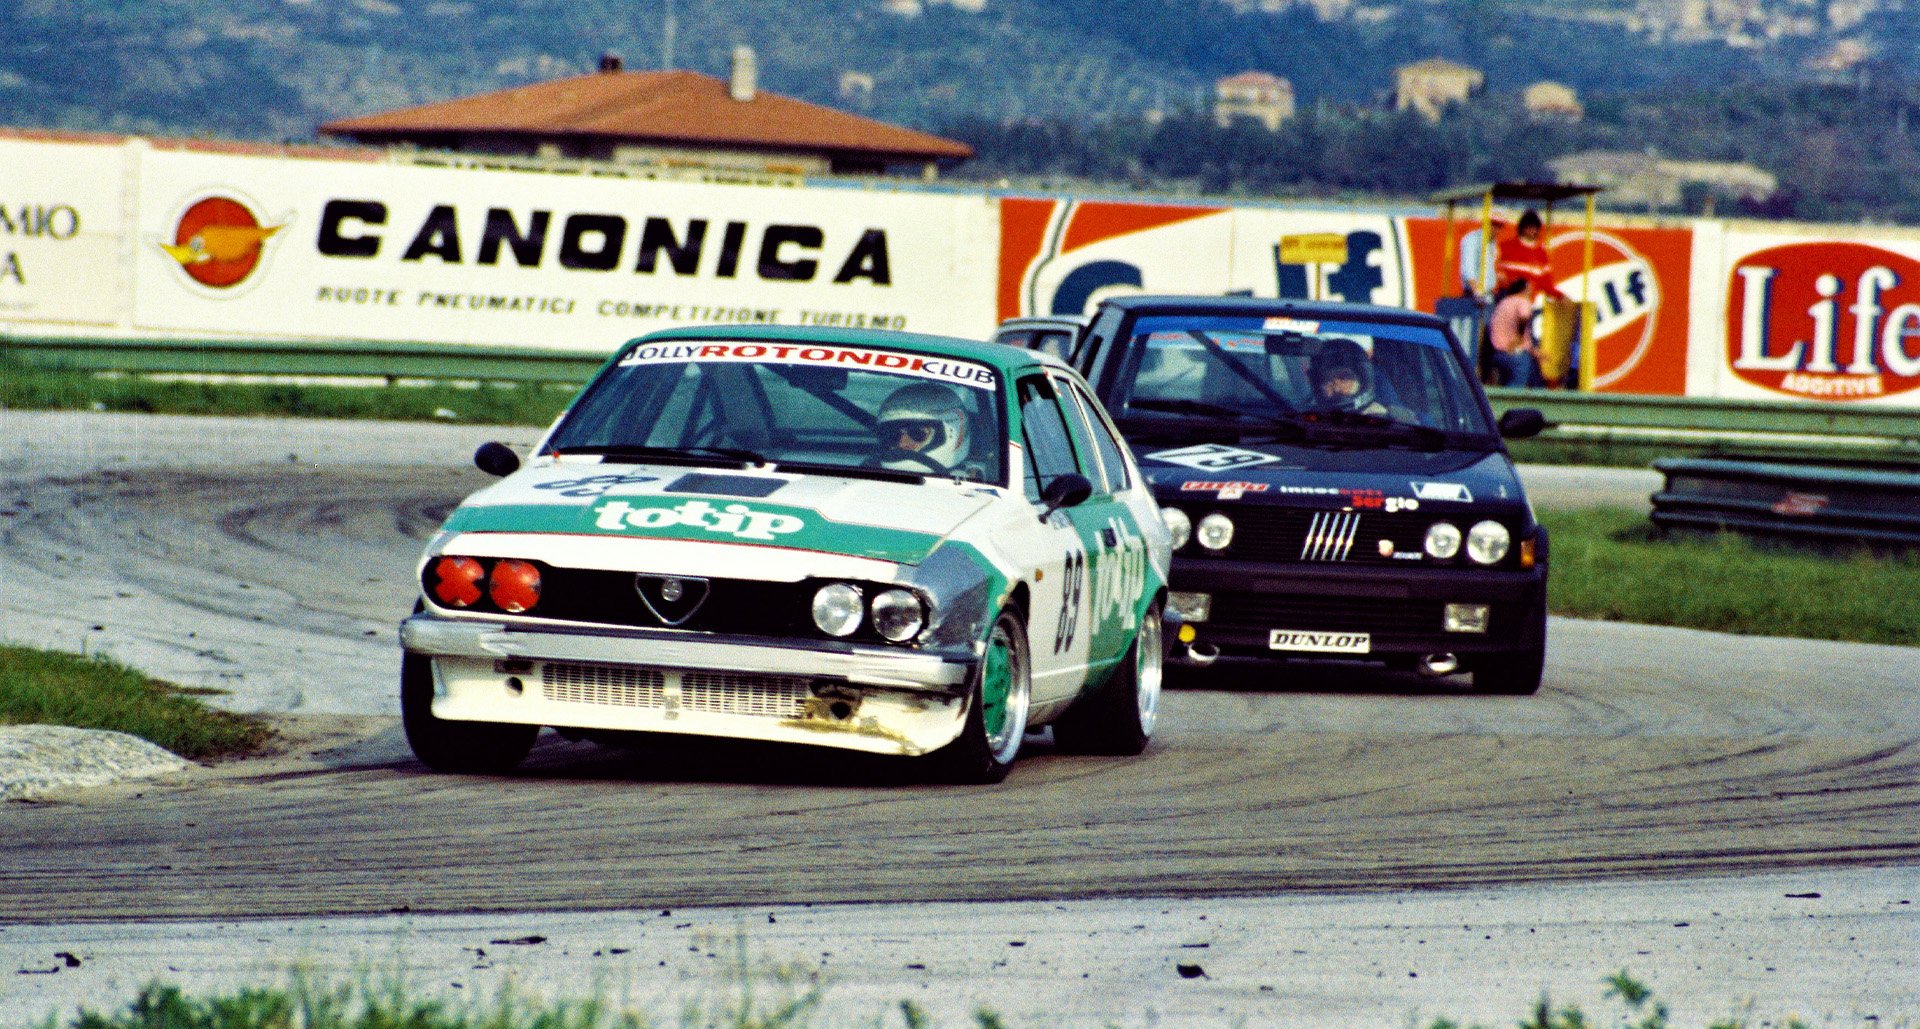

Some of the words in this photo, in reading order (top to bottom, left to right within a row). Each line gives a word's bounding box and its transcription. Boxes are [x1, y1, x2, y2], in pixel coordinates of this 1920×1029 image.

[317, 198, 892, 287] CANONICA
[317, 286, 403, 305] RUOTE
[417, 291, 577, 315] PNEUMATICI
[597, 299, 780, 325] COMPETIZIONE
[799, 309, 907, 332] TURISMO
[921, 361, 994, 384] CLUB
[594, 500, 805, 541] totip
[1054, 548, 1083, 655] 89
[1272, 632, 1369, 648] DUNLOP
